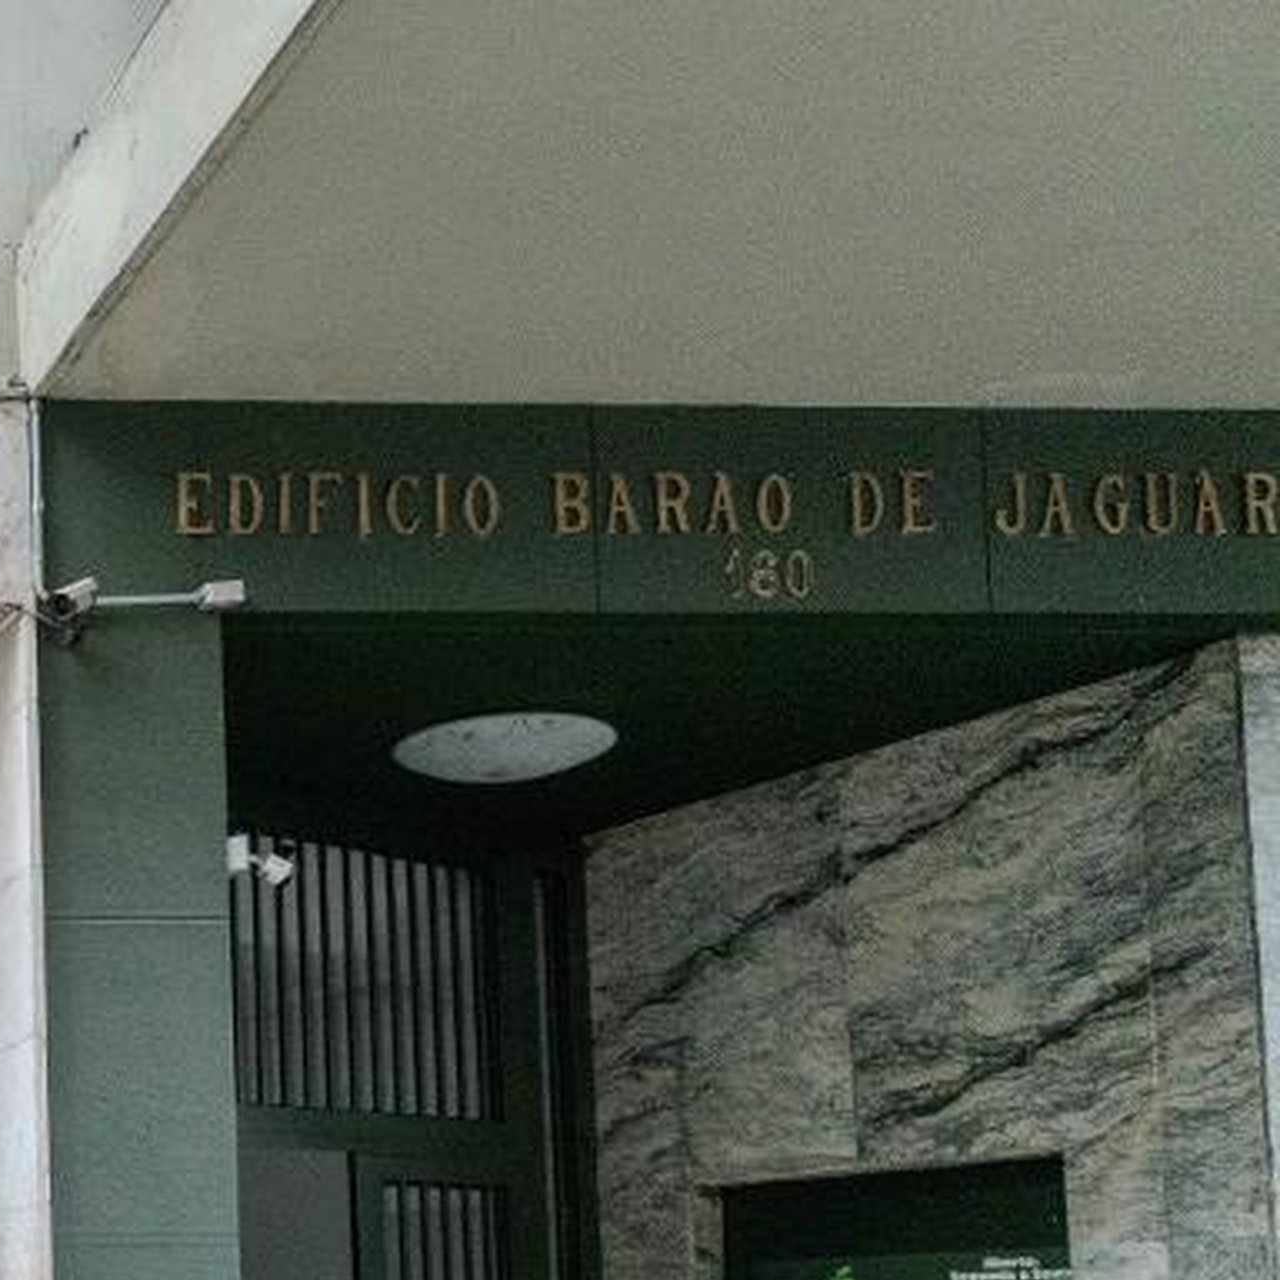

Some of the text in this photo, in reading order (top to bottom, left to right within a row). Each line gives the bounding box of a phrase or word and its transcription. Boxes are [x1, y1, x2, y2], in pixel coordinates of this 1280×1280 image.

[174, 469, 1280, 538] EDIFICIO BARAO DE JAGUAR
